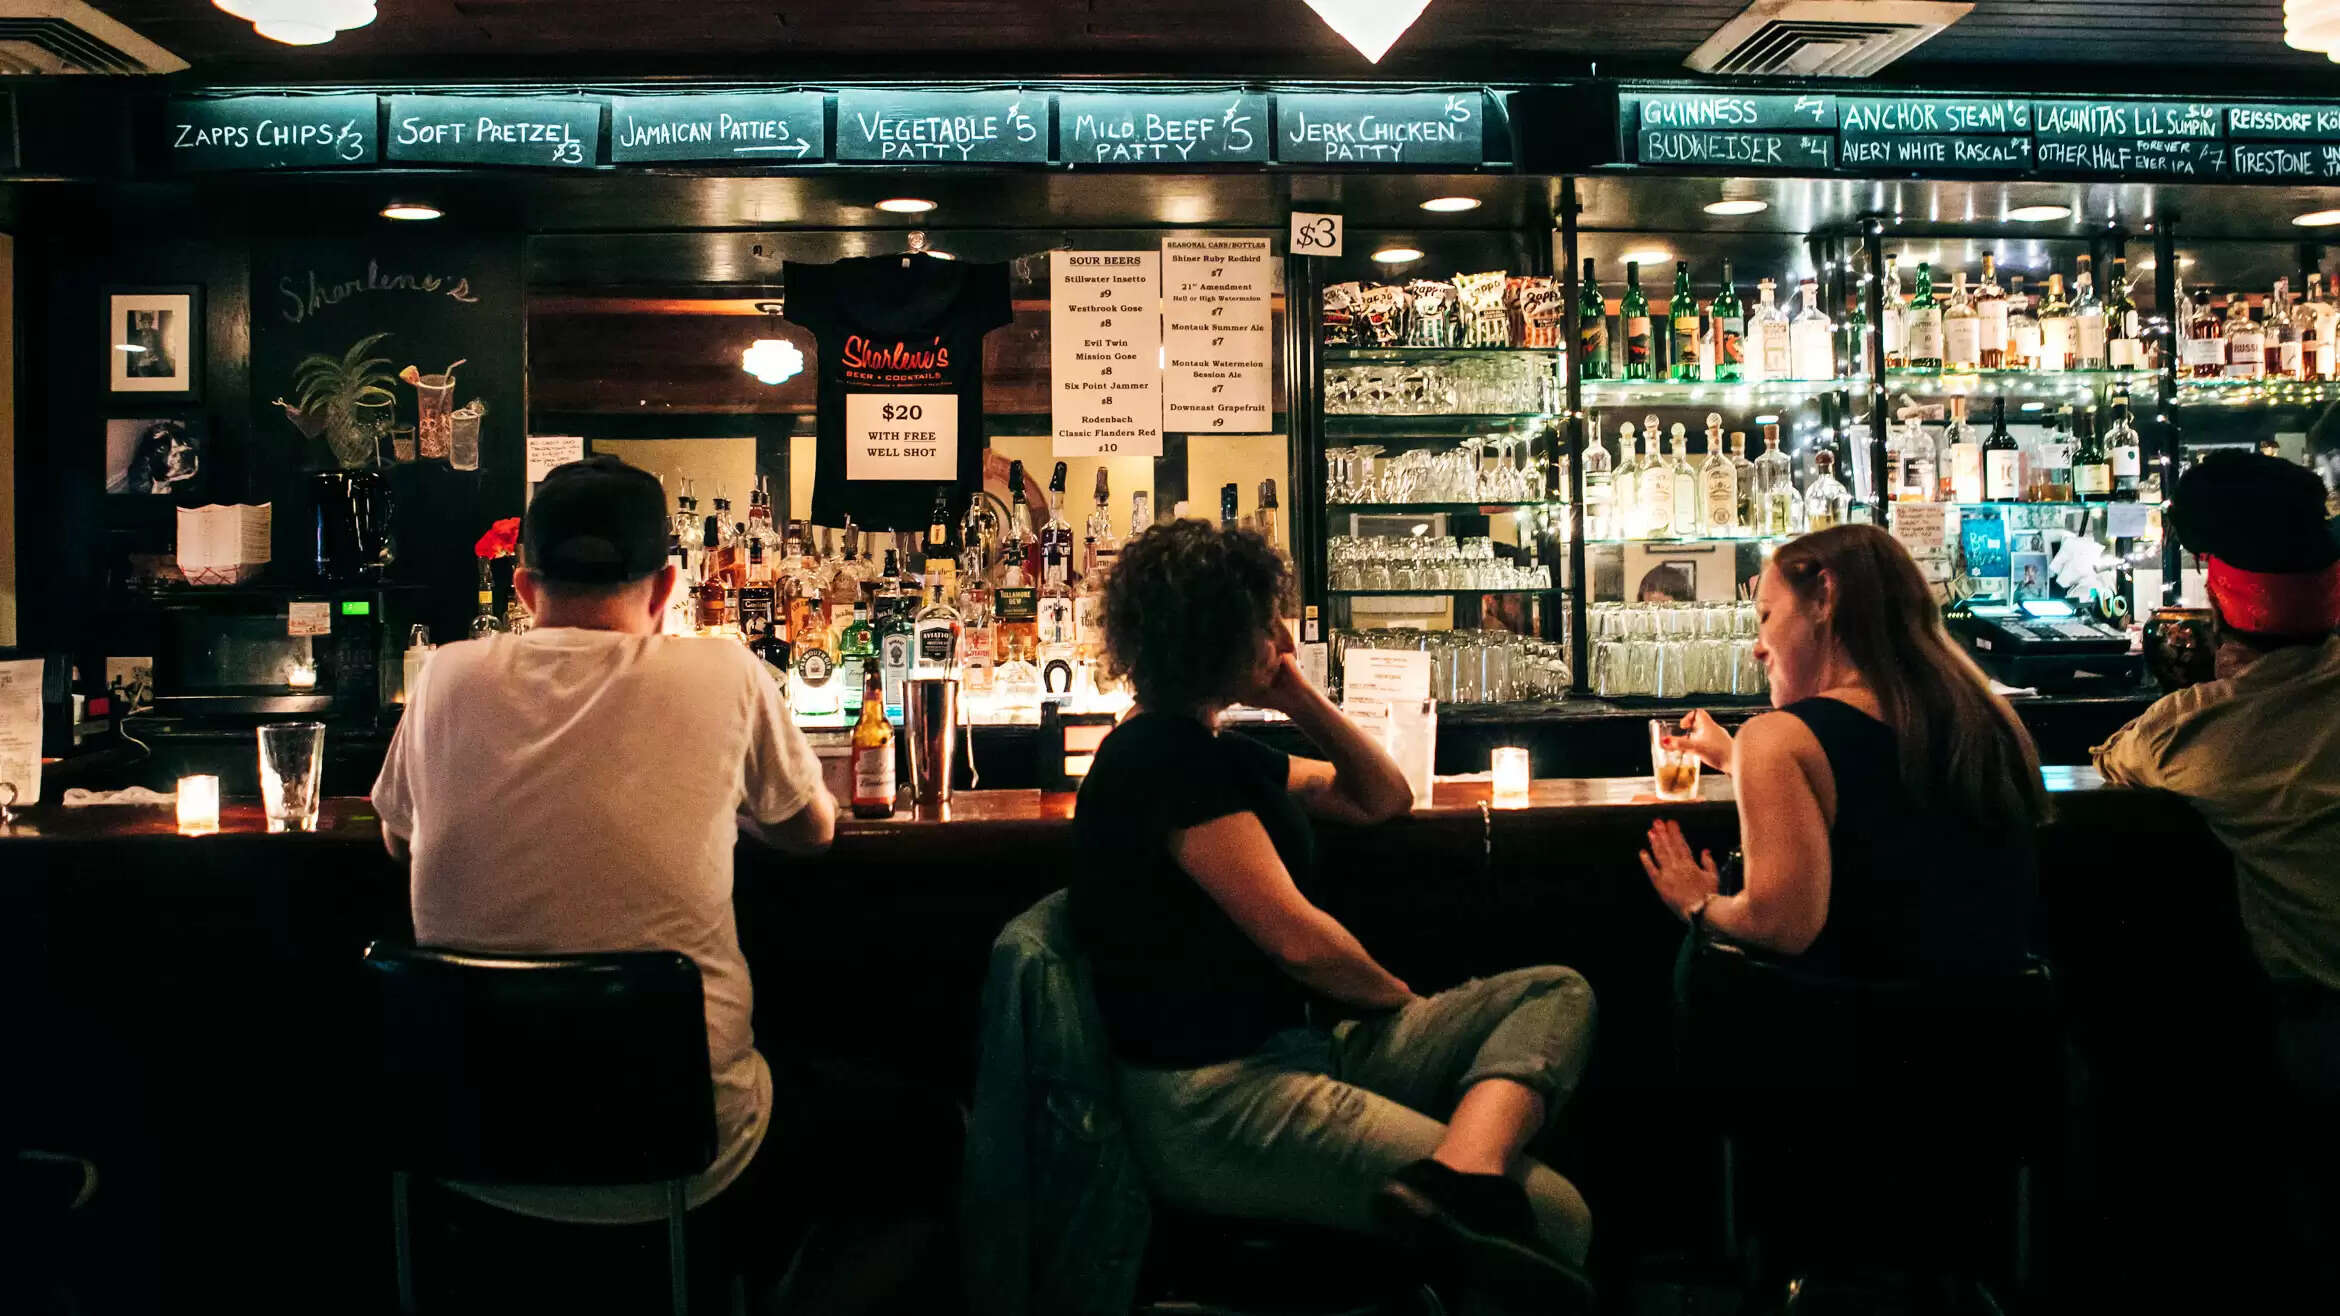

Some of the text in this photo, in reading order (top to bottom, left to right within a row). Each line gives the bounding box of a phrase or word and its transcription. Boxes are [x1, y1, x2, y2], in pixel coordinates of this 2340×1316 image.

[1444, 95, 1471, 123] $5
[1644, 95, 1826, 127] GUINNESS $7
[857, 101, 1037, 143] VEGETABLE $5
[1843, 103, 1939, 131] ANCHOR
[1945, 103, 2006, 133] STEAM
[2037, 106, 2127, 137] LAGUNITAS
[2167, 109, 2216, 138] SUMPIN
[2230, 108, 2312, 133] REISSDORF
[397, 116, 581, 145] SOFT PRETZEL
[620, 112, 790, 148] JAMAICAN PATTIES
[1074, 99, 1254, 151] MILD BEEF $5
[1289, 111, 1455, 143] JERK CHICKEN
[173, 118, 364, 161] ZAPPS CHIPS $3
[881, 141, 976, 162] PATTY
[1096, 140, 1197, 163] PATTY
[1325, 141, 1404, 163] PATTY
[1649, 132, 1829, 168] BUDWEISER $4
[1842, 138, 1891, 163] AVERY
[1898, 141, 1945, 162] WHITE
[1954, 140, 2018, 163] RASCAL
[2136, 140, 2192, 153] FOREVER
[552, 143, 583, 164] $3
[2038, 143, 2132, 170] OTHER HALF
[2135, 155, 2195, 176] EVER IPA
[2234, 145, 2315, 176] FIRESTONE
[1296, 217, 1337, 249] $3
[1069, 256, 1142, 266] SOUR BEERS
[1172, 254, 1262, 265] Shiner Ruby Redbird
[1210, 268, 1224, 278] $7
[1064, 275, 1147, 284] Stillwater Insetto
[1199, 283, 1253, 291] Amendment
[1099, 289, 1112, 299] $9
[1199, 295, 1217, 303] High
[1068, 304, 1144, 313] Westbrook Gose
[1211, 307, 1224, 317] $7
[1099, 318, 1113, 328] $8
[1171, 323, 1265, 332] Montauk Summer Ale
[1084, 339, 1129, 348] Evil Twin
[1211, 337, 1225, 347] $7
[841, 335, 950, 371] Sharlene's
[1075, 352, 1138, 361] Mission Gose
[1171, 359, 1264, 368] Montauk Watermelon
[845, 370, 943, 381] BEER COCKTAILS
[1100, 366, 1113, 376] $8
[1192, 370, 1243, 379] Session Ale
[1064, 382, 1149, 390] Six Point Jammer
[1211, 384, 1225, 394] $7
[1101, 396, 1114, 406] $8
[881, 402, 923, 423] $20
[1170, 403, 1266, 414] Downeast Grapefruit
[1081, 415, 1134, 424] Rodenbach
[1212, 417, 1225, 427] $9
[868, 431, 937, 442] WITH FREE
[1059, 428, 1157, 438] Classic Flanders Red
[867, 448, 937, 457] WELL SHOT
[1098, 443, 1119, 453] $10
[922, 632, 950, 640] AVIATIO
